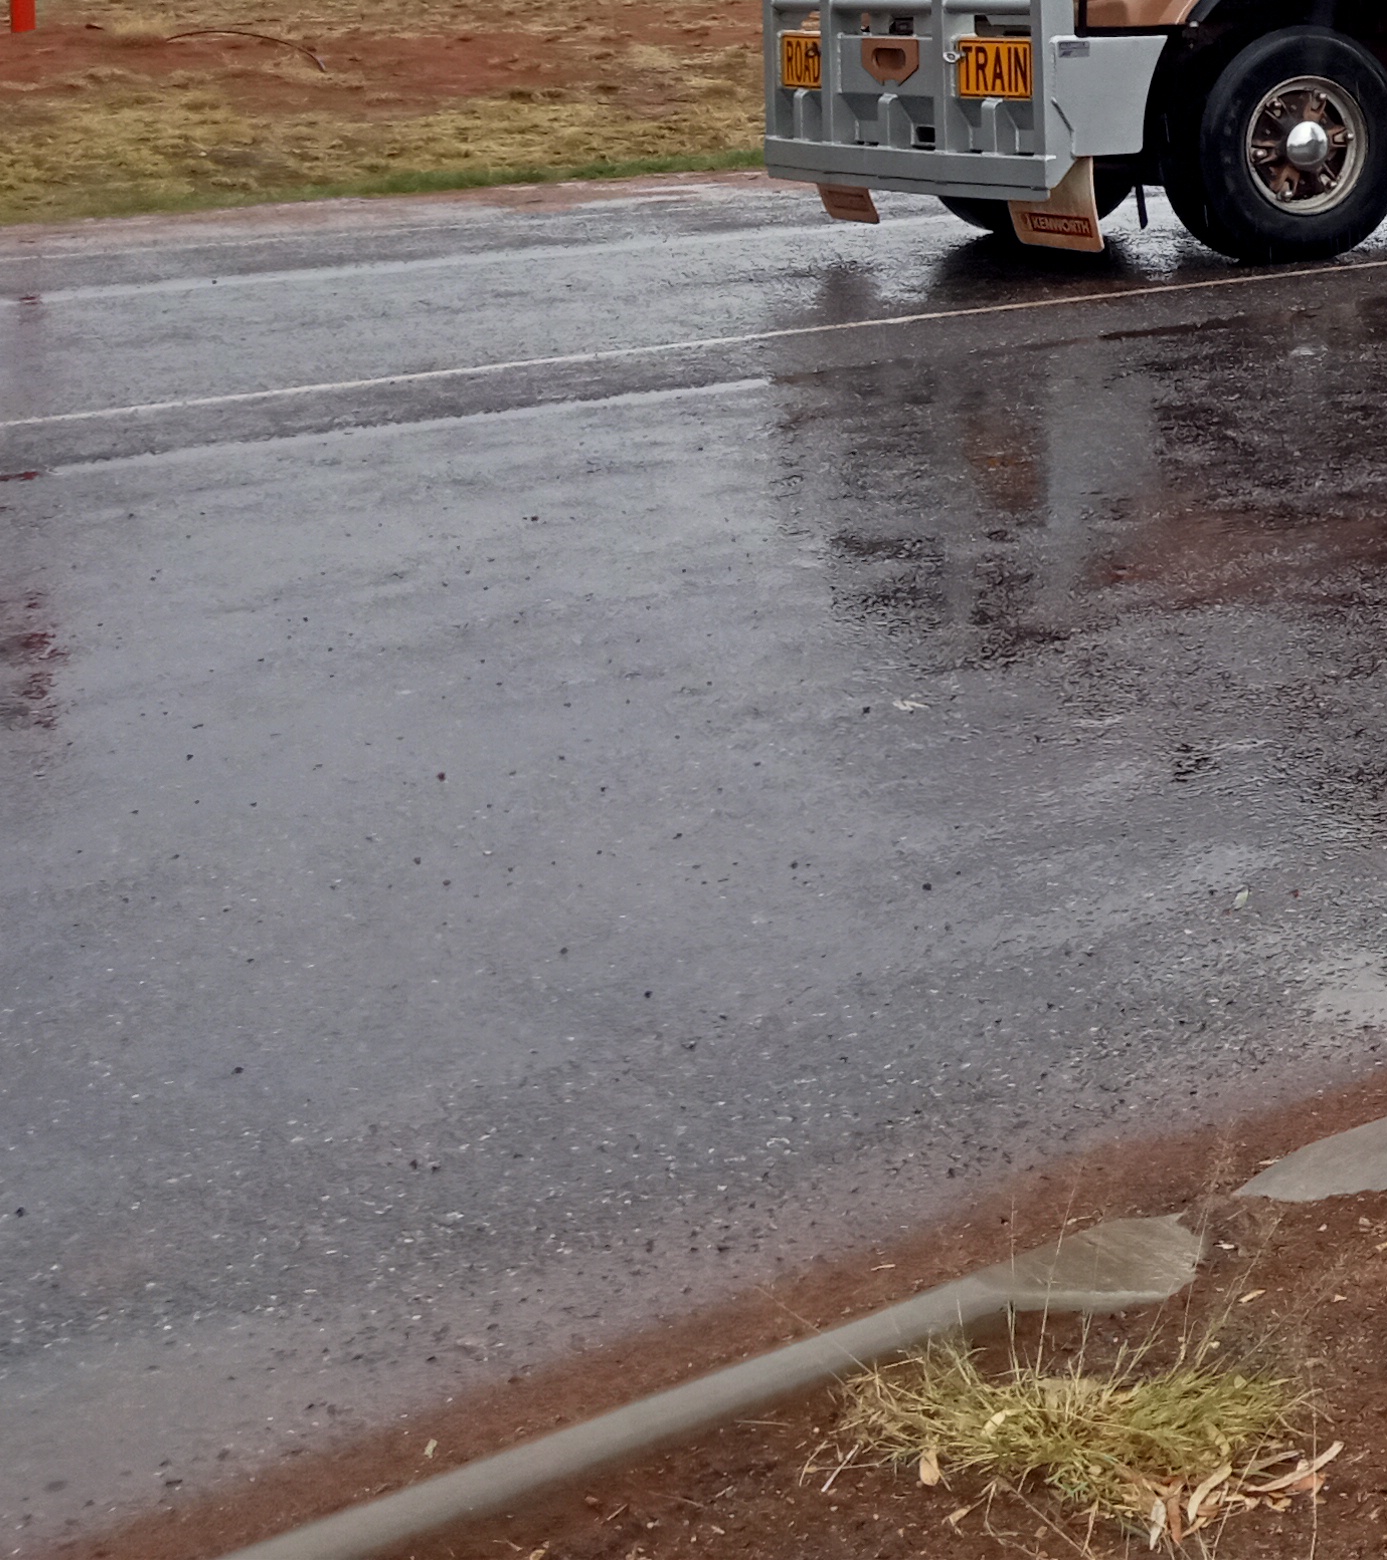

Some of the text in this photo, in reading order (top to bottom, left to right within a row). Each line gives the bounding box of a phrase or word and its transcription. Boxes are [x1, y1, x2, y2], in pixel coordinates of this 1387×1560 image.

[786, 38, 1028, 93] ROAD TRAIN
[1031, 216, 1091, 234] KENWORTH
